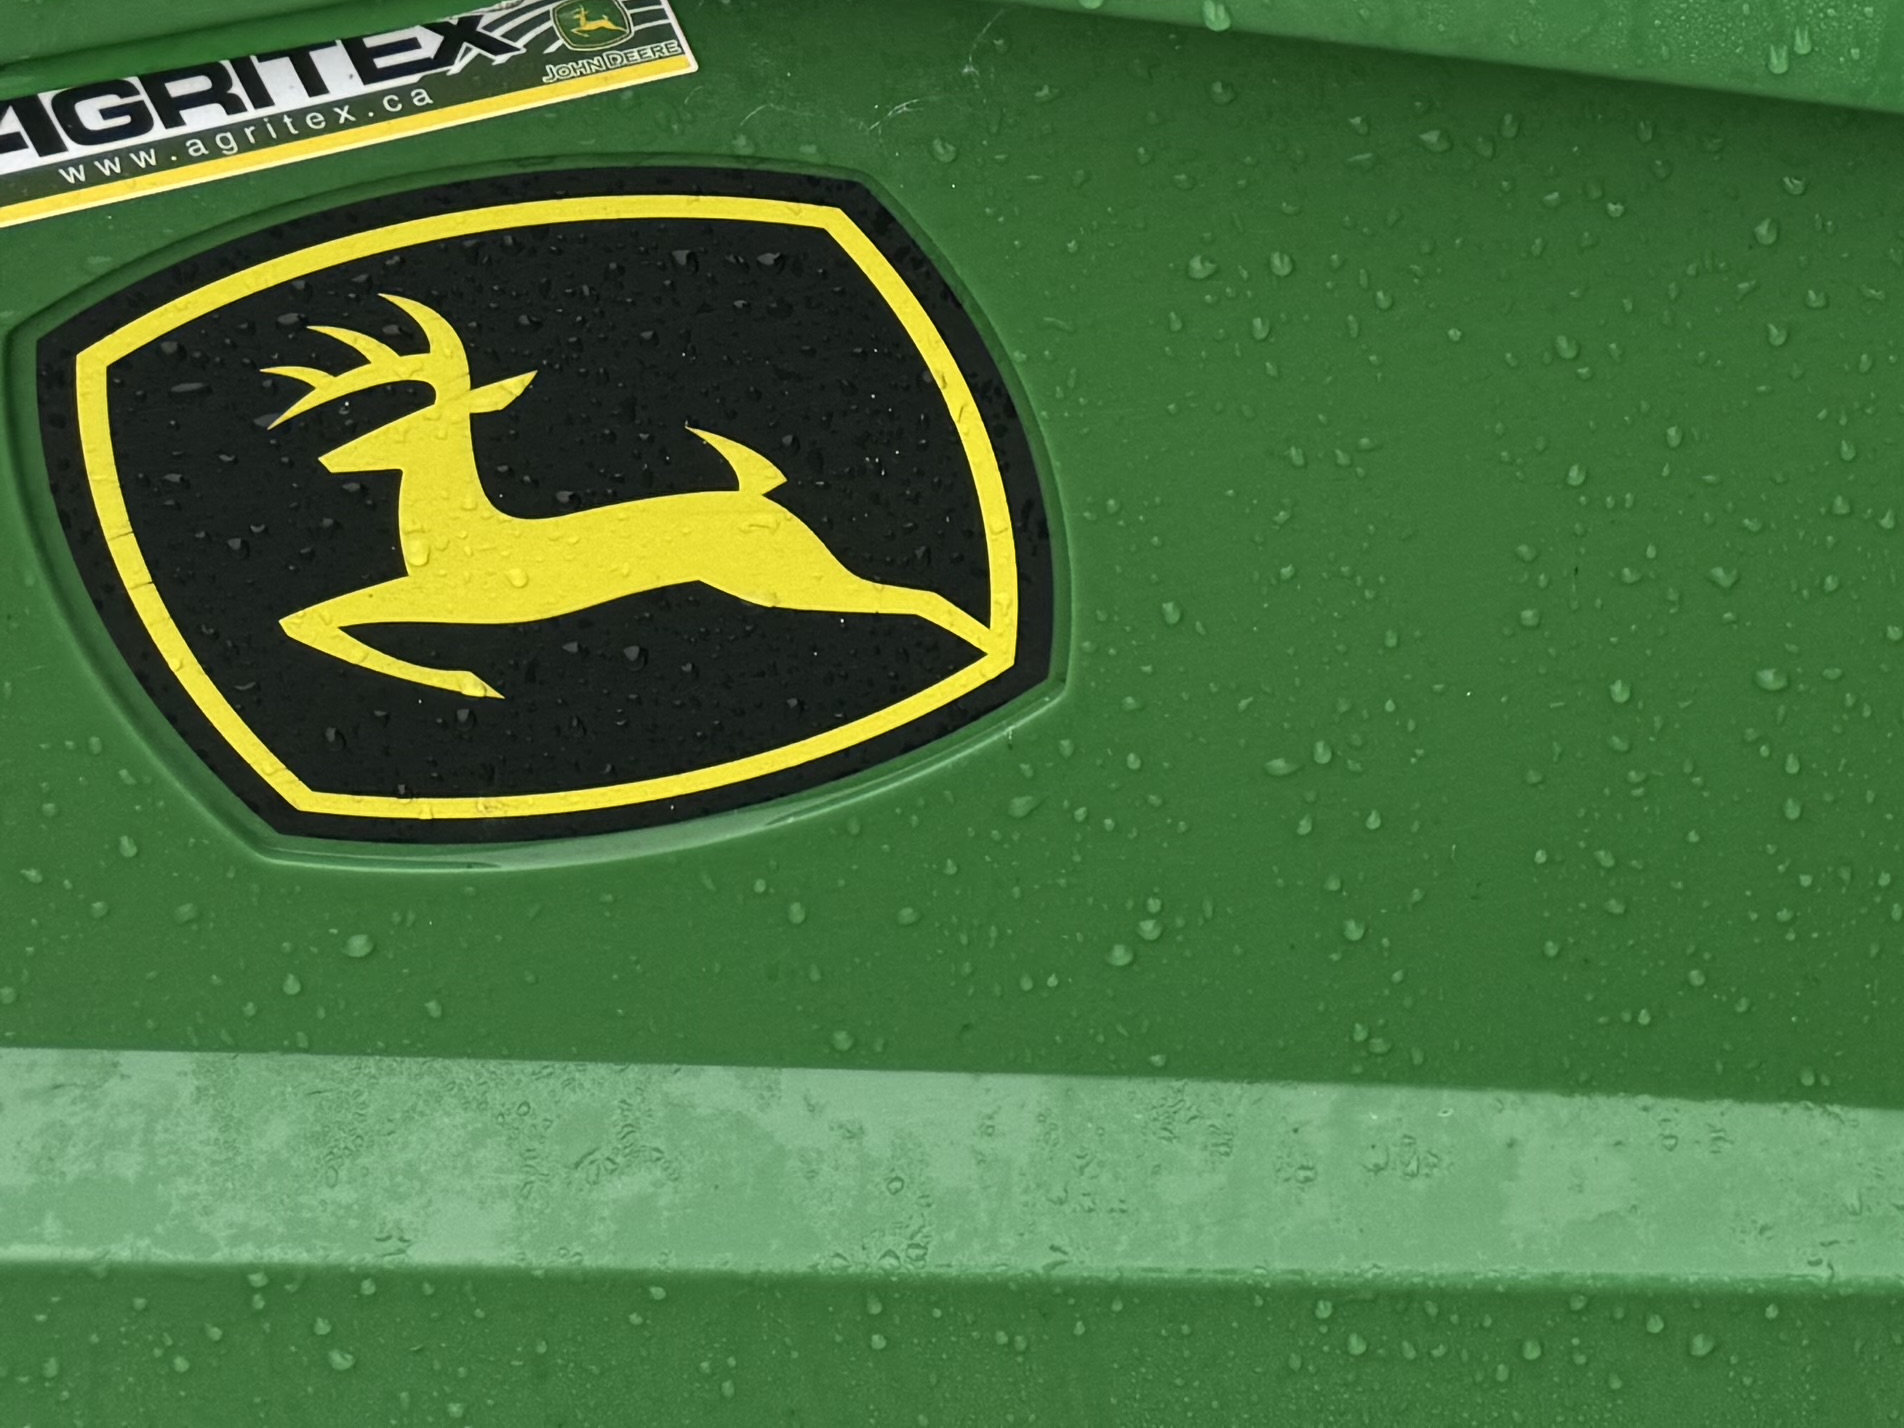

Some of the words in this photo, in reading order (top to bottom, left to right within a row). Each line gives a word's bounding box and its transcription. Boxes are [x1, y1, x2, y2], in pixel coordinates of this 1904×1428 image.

[543, 56, 605, 83] JOHN
[602, 39, 682, 69] DEERE
[58, 87, 434, 184] www.agritex.ca
